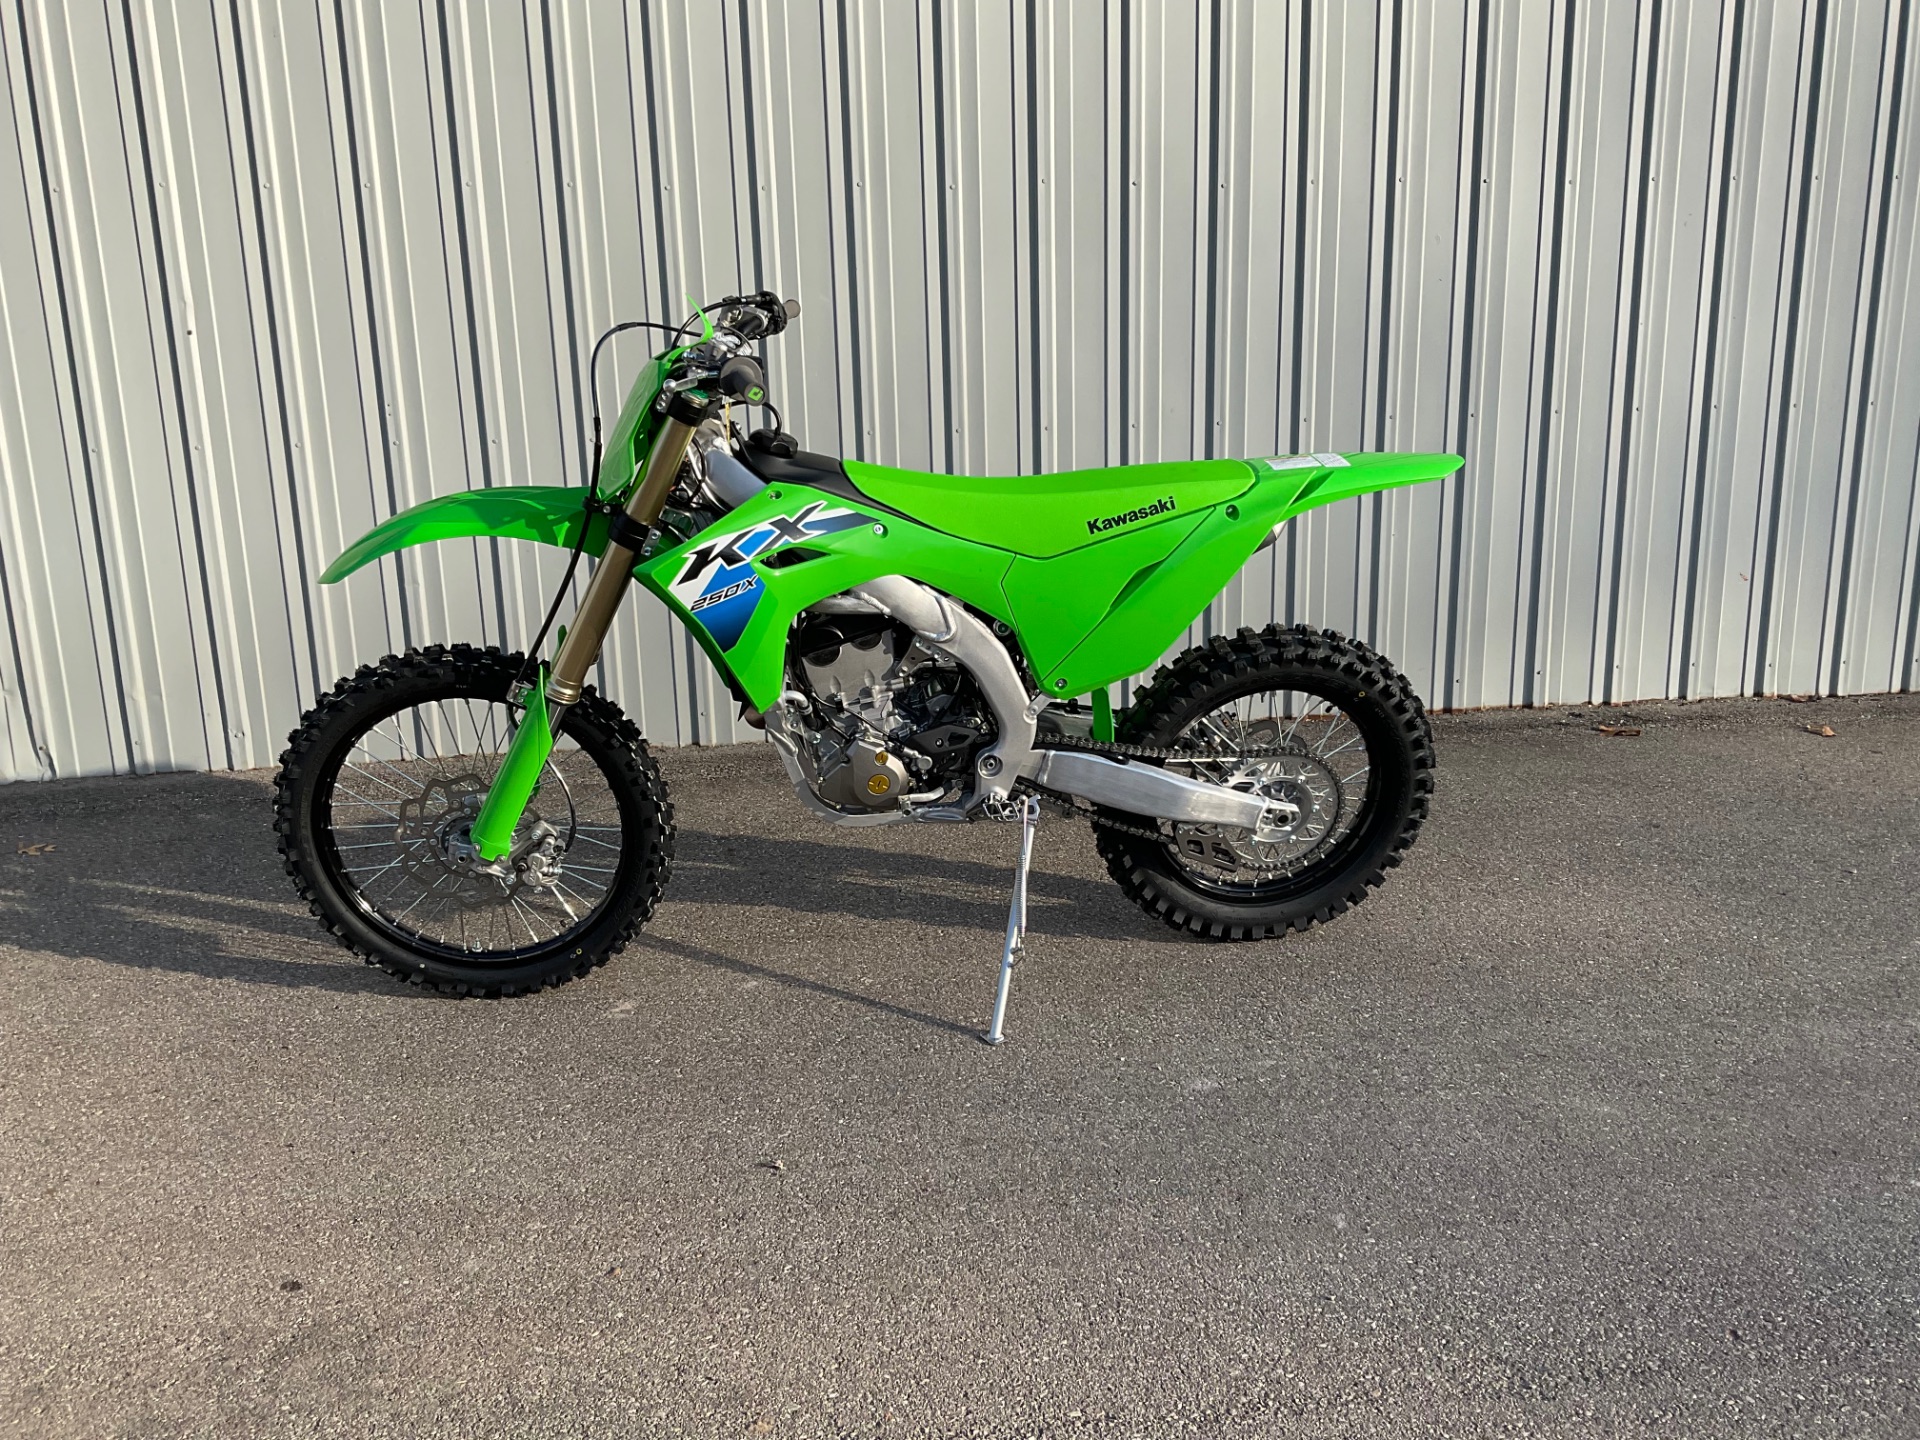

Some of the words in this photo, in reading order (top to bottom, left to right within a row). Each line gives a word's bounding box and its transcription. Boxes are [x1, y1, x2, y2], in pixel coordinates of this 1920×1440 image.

[1086, 495, 1176, 535] Kawasaki
[676, 501, 826, 586] KX
[690, 574, 758, 611] 250X
